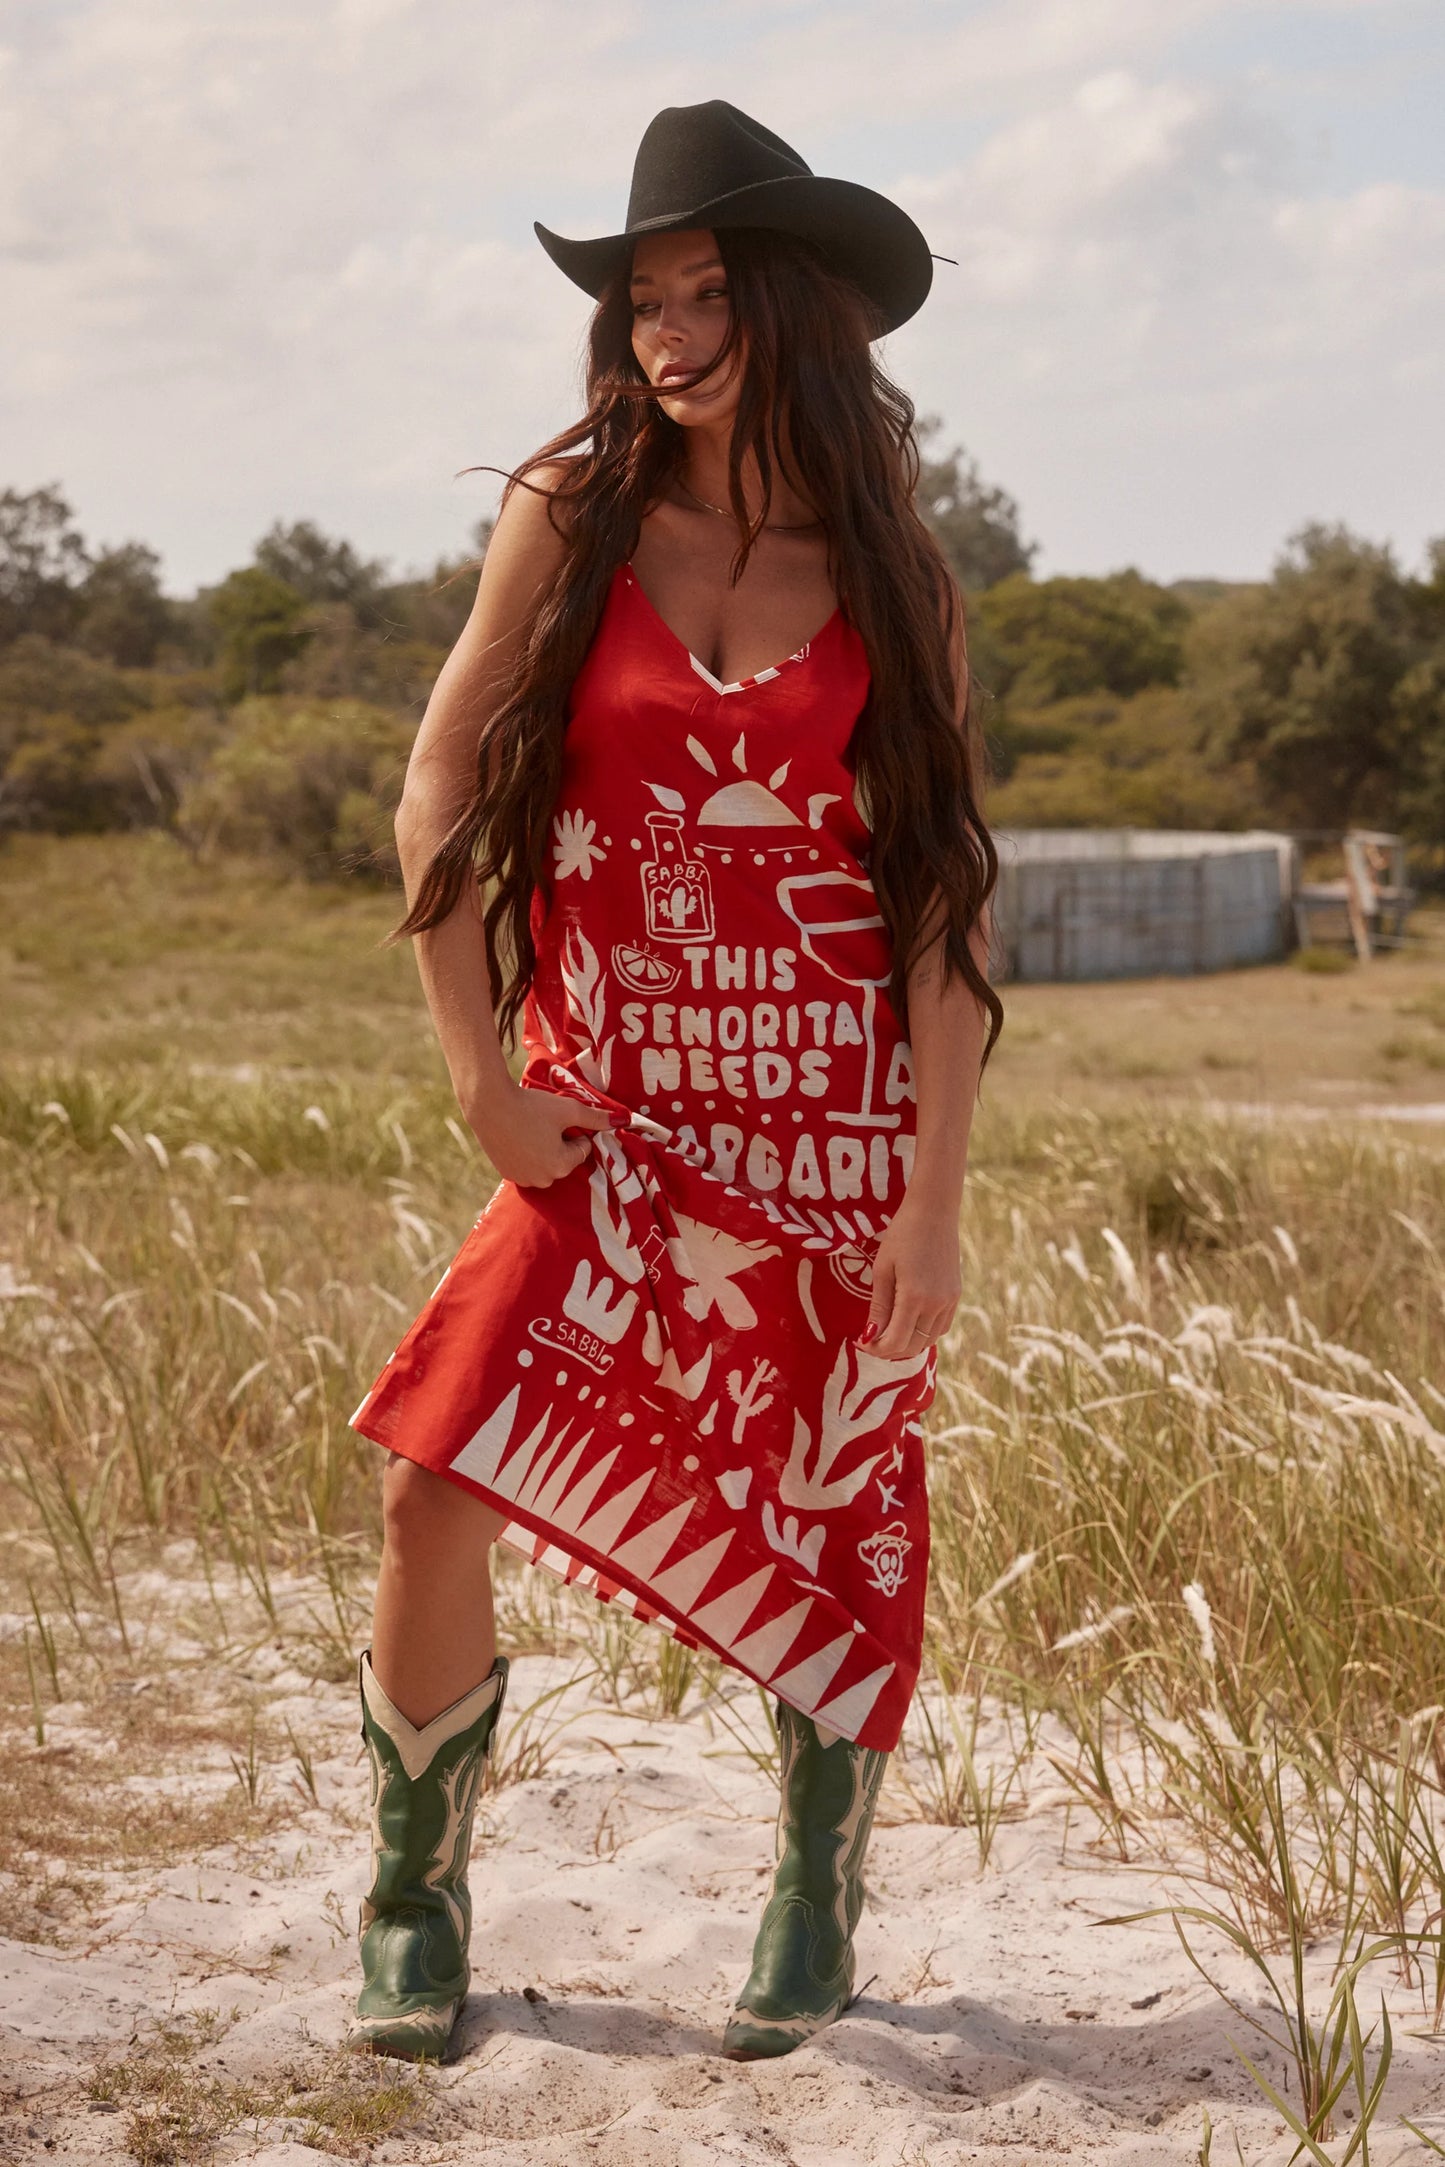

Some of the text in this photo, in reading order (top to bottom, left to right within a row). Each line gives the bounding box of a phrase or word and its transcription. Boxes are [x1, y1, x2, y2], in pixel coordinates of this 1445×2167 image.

[648, 864, 706, 885] SABBI
[683, 945, 797, 991] THIS
[620, 1001, 864, 1050] SENORITA
[641, 1048, 832, 1099] NEEDS
[556, 1322, 606, 1362] SABBI
